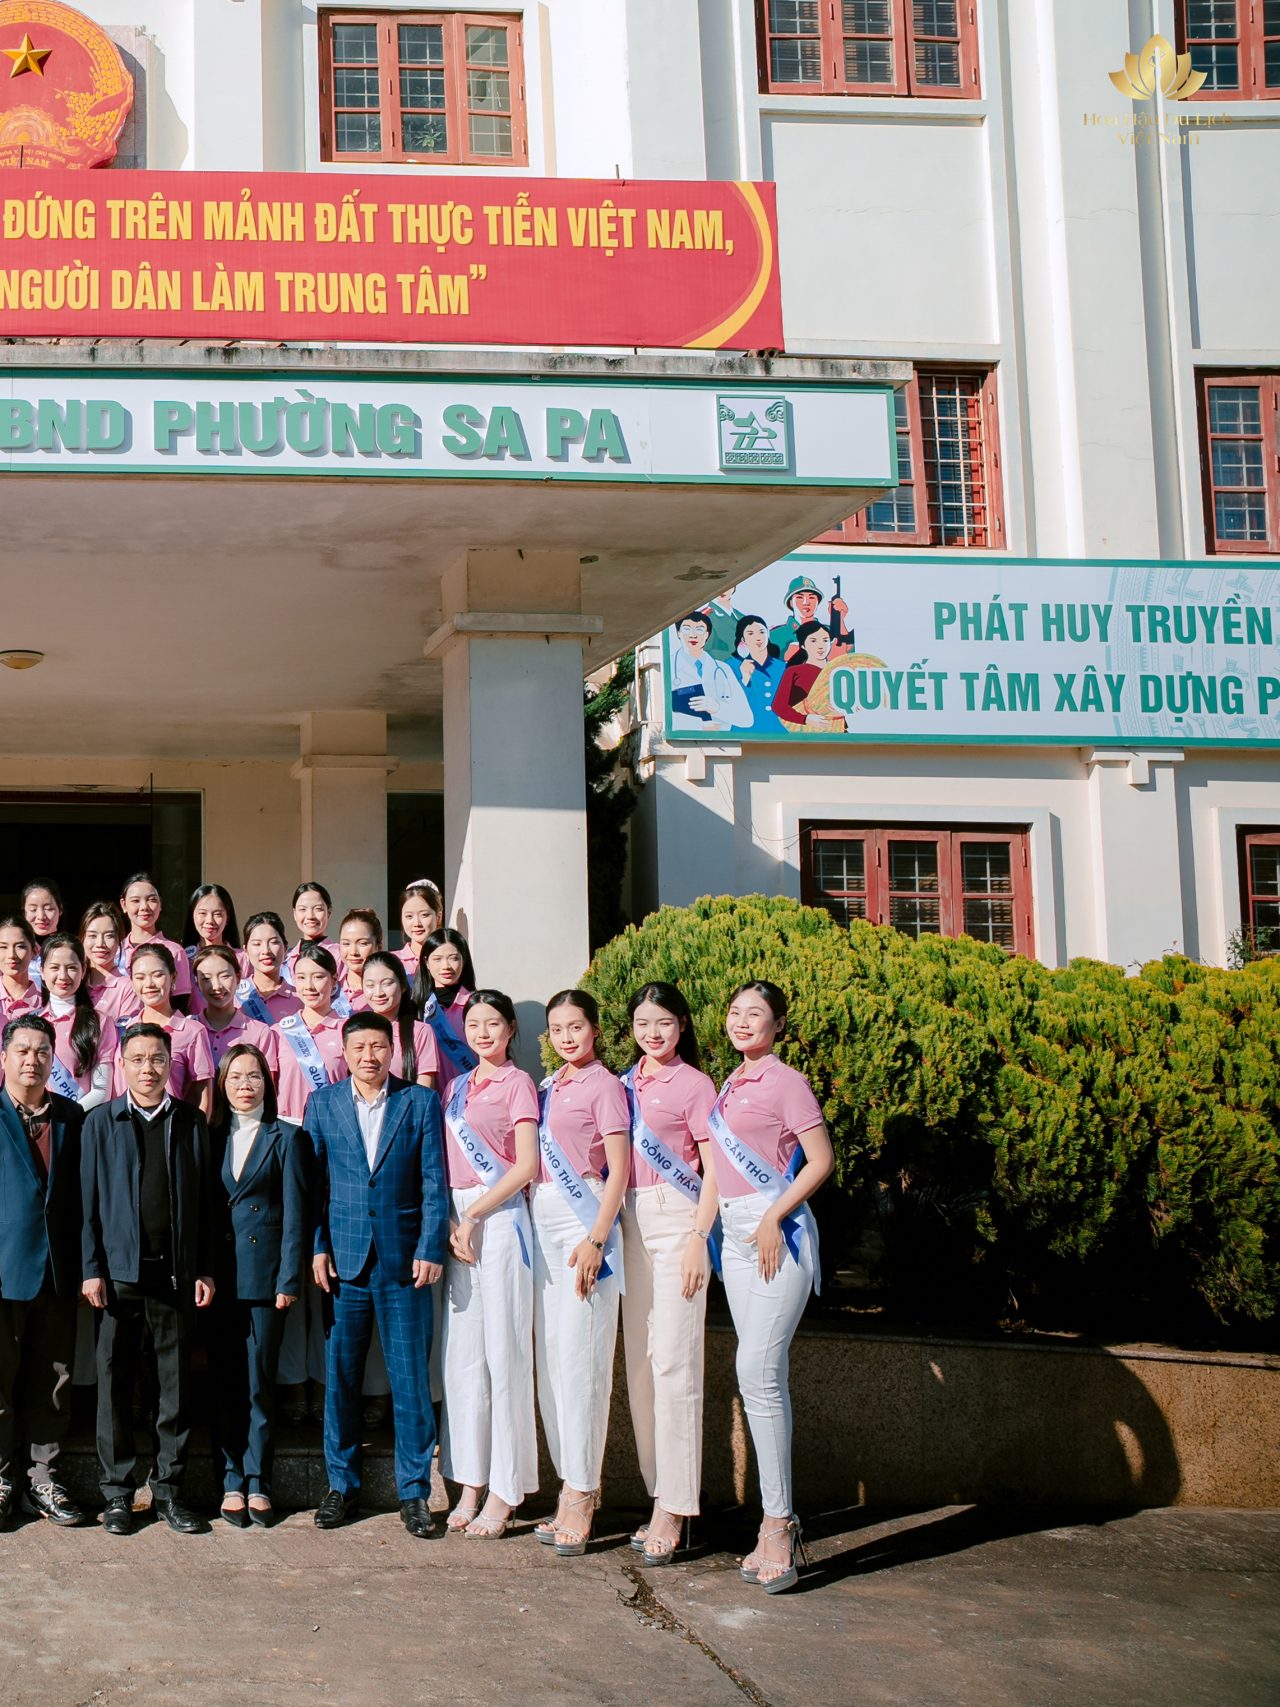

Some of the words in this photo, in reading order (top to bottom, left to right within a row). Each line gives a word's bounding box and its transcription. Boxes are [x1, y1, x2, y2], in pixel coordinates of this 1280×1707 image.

[2, 190, 96, 240] ĐỨNG
[106, 191, 191, 241] TRÊN
[203, 187, 305, 242] MẢNH
[314, 189, 379, 243] ĐẤT
[388, 200, 474, 254] THỰC
[482, 192, 558, 248] TIỄN
[567, 200, 637, 257] VIỆT
[647, 208, 735, 256] NAM,
[111, 261, 181, 311] DÂN
[192, 262, 265, 312] LÀM
[275, 271, 387, 314] TRUNG
[397, 264, 487, 315] TÂM”
[153, 389, 417, 455] PHƯỜNG
[442, 404, 528, 458] SA
[546, 406, 627, 460] PA
[934, 594, 1028, 642] PHÁT
[1042, 603, 1113, 643] HUY
[1125, 593, 1273, 646] TRUYỀN
[832, 657, 949, 715] QUYẾT
[960, 664, 1041, 713] TÂM
[1055, 664, 1125, 714] XÂY
[1140, 671, 1245, 723] DỰNG
[458, 1128, 475, 1152] LÀO
[474, 1152, 493, 1174] CAI
[640, 1138, 672, 1170] ĐỒNG
[672, 1168, 699, 1193] THÁP
[745, 1160, 772, 1184] THƠ
[558, 1169, 583, 1200] THÁP
